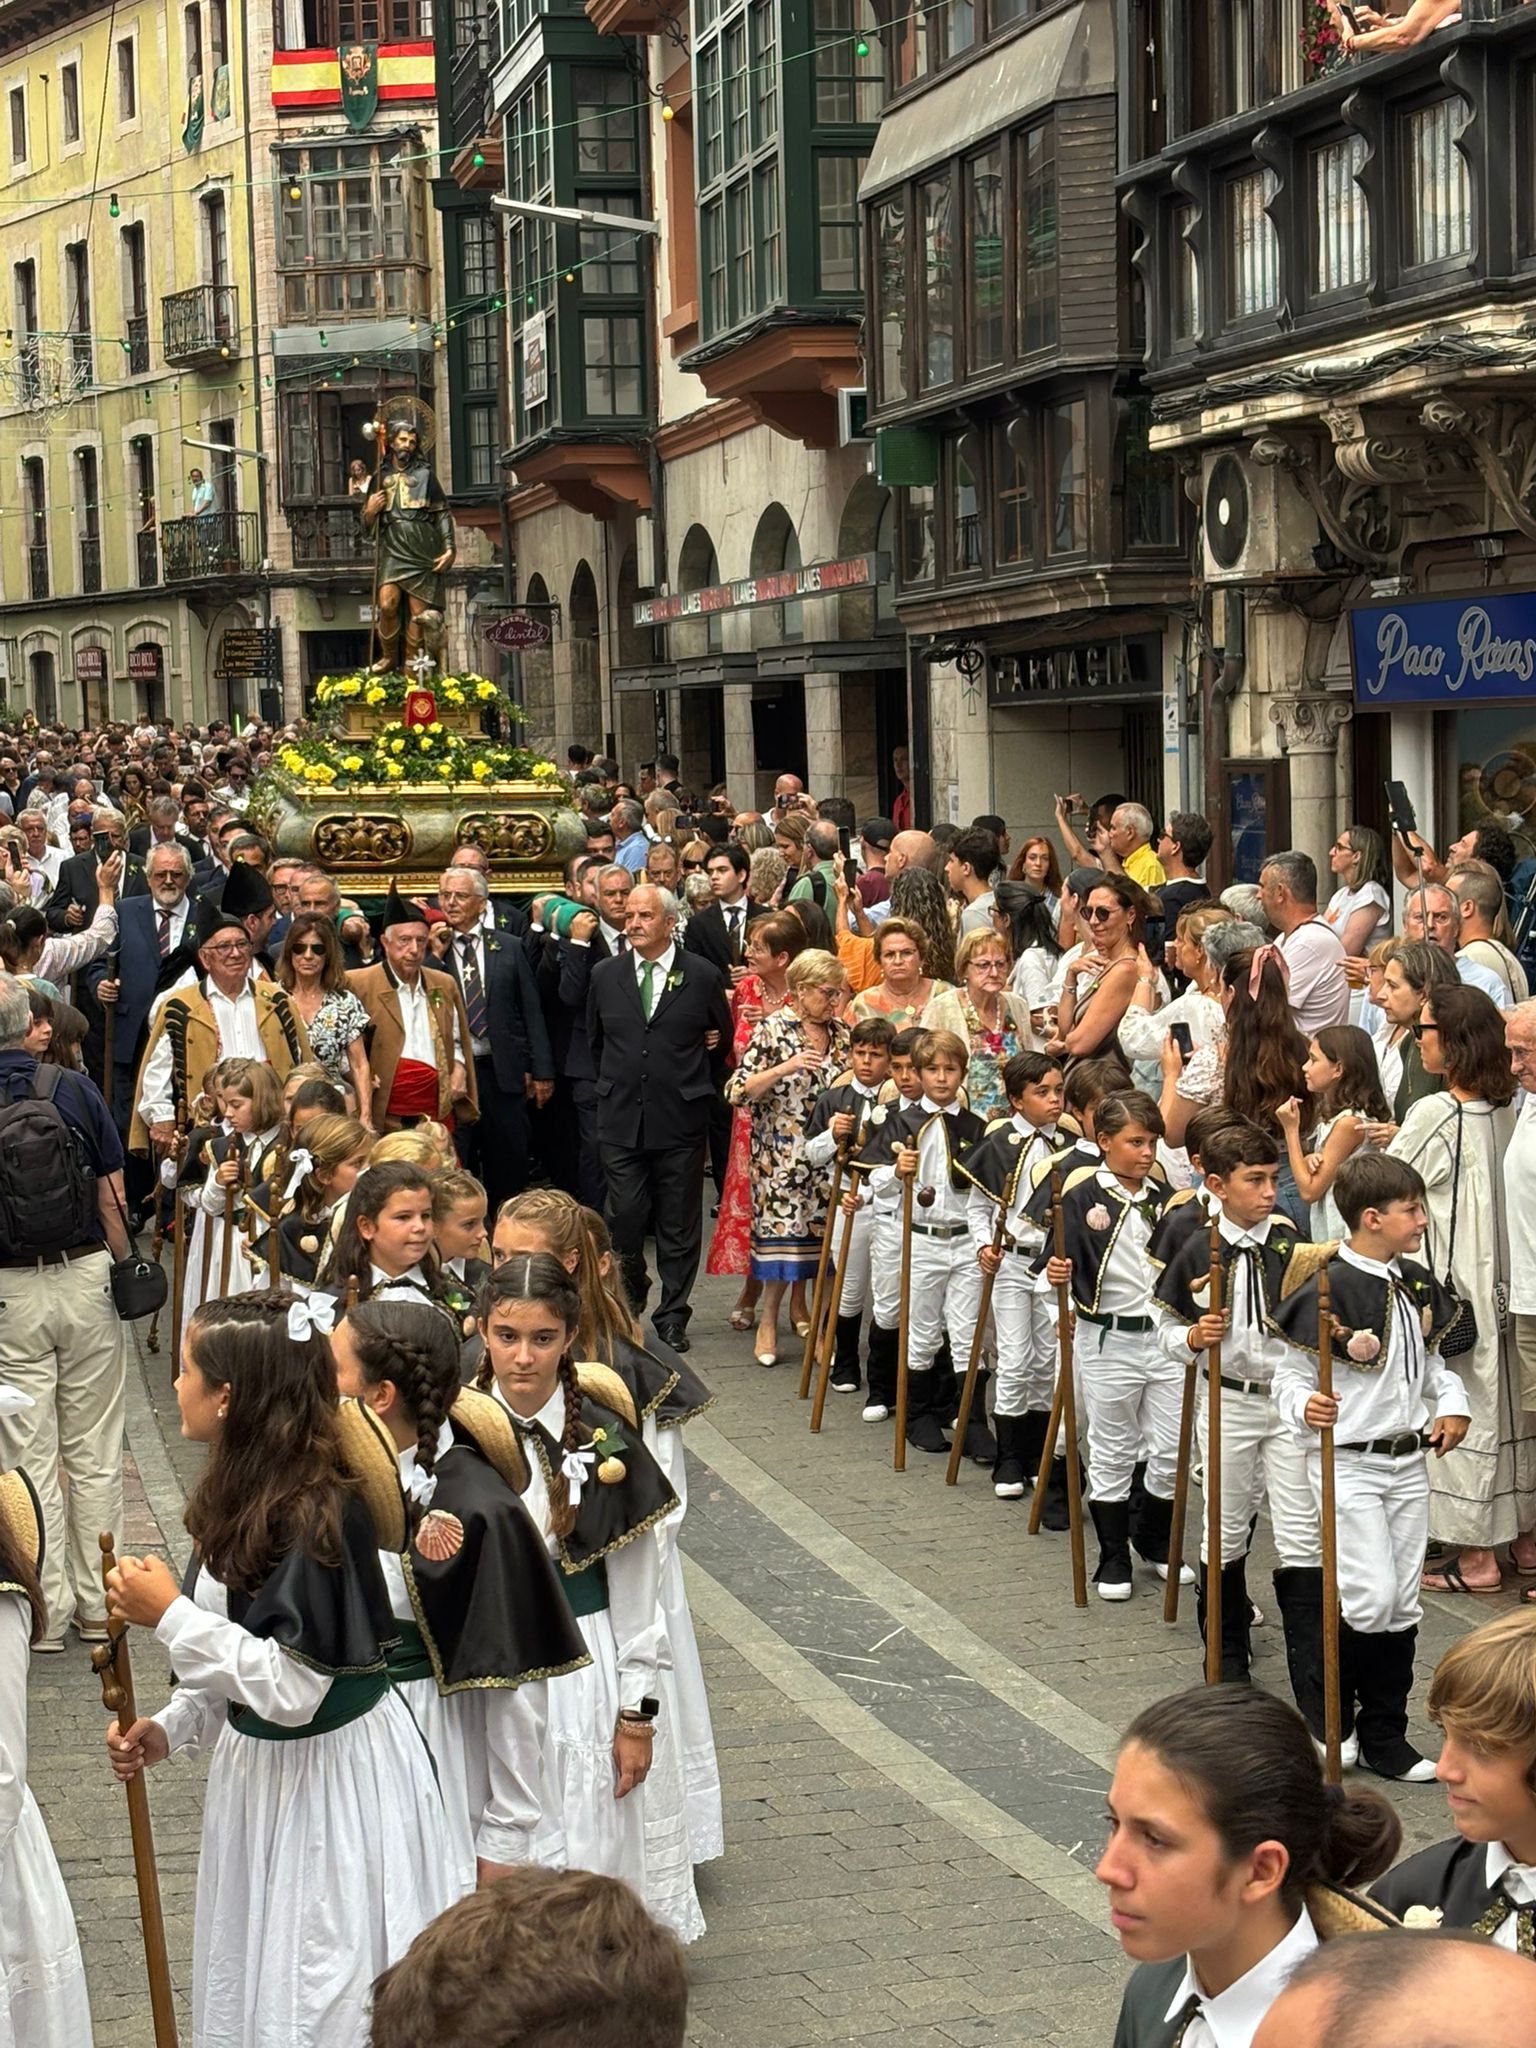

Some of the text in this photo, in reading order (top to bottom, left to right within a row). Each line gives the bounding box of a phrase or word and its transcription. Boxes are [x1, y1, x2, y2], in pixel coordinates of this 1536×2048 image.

[796, 567, 821, 594] LLANES
[490, 625, 544, 640] el dintel
[1366, 613, 1446, 695] Paco
[995, 644, 1133, 694] FARMACIA
[1500, 1313, 1508, 1330] EL
